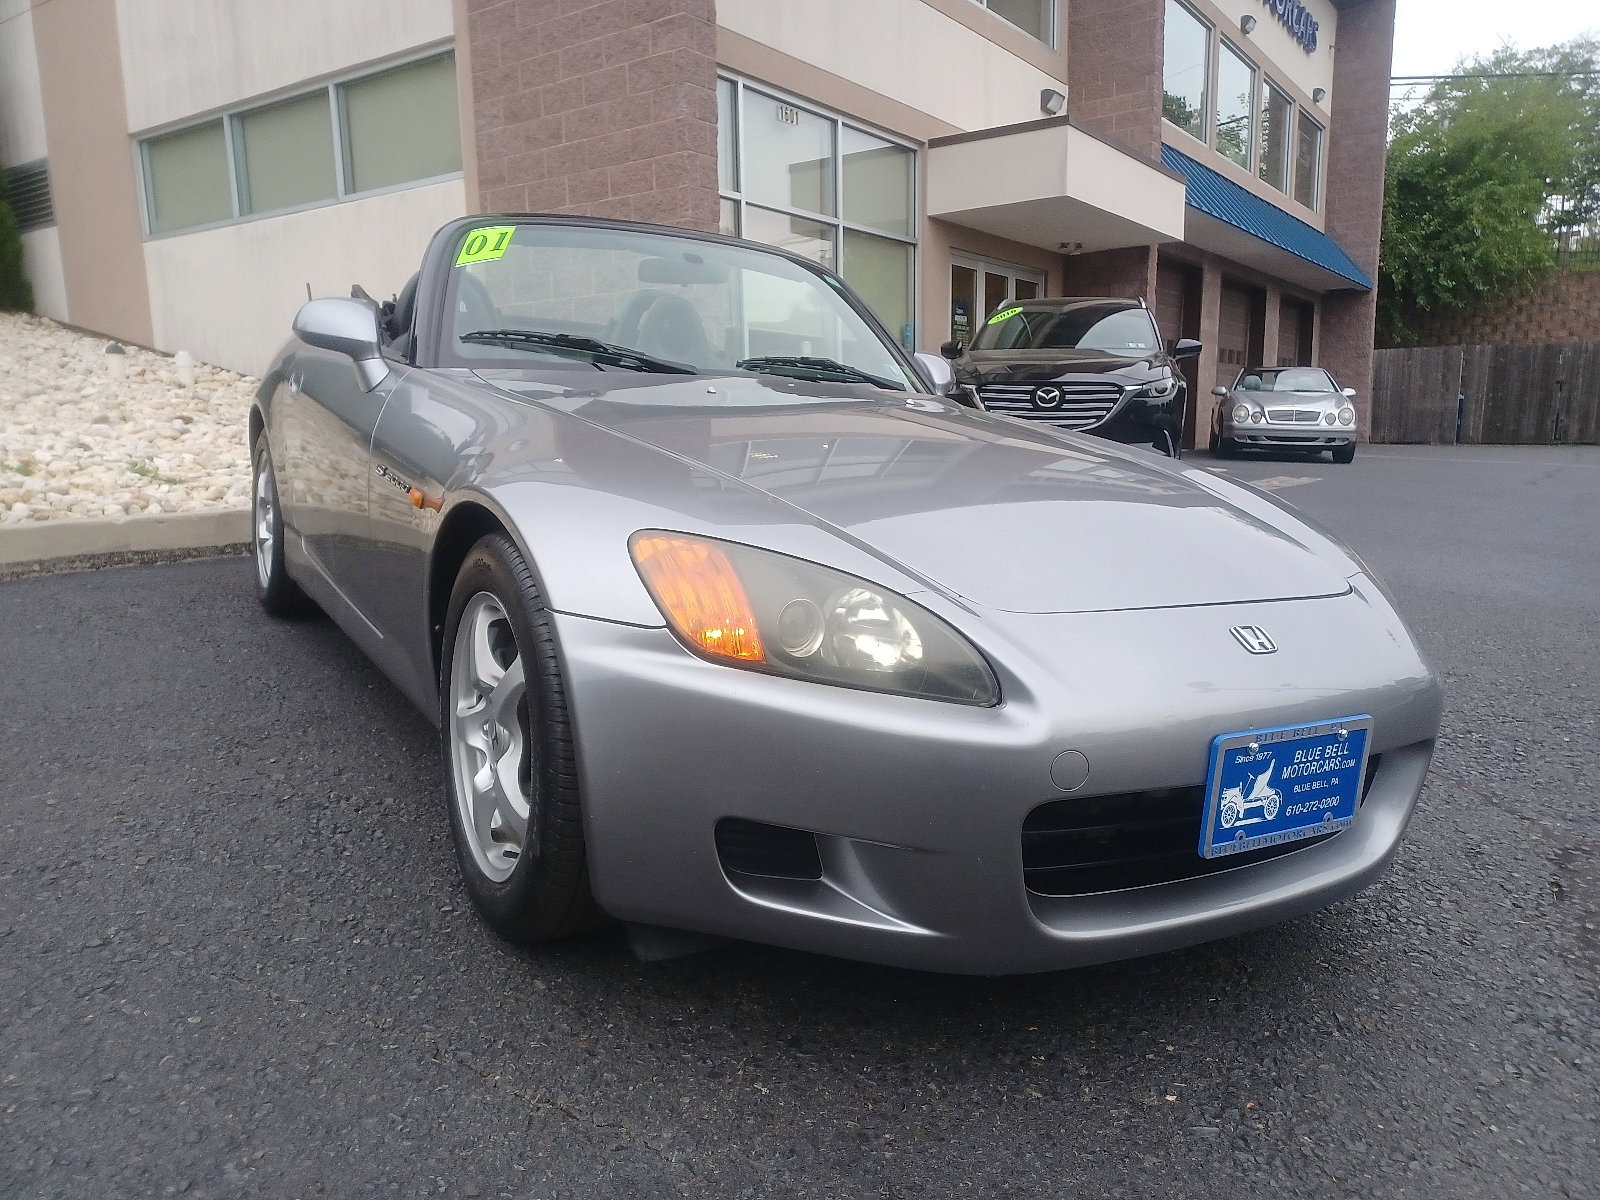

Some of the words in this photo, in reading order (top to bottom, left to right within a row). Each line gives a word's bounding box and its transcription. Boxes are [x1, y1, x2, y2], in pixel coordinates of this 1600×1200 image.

[465, 231, 509, 256] 01
[1235, 754, 1254, 764] Since
[1255, 751, 1273, 761] 1977
[1294, 746, 1323, 763] BLUE
[1324, 742, 1349, 758] BELL
[1293, 783, 1311, 794] BLUE
[1331, 777, 1339, 786] PA
[1286, 796, 1340, 816] 610-272-0200
